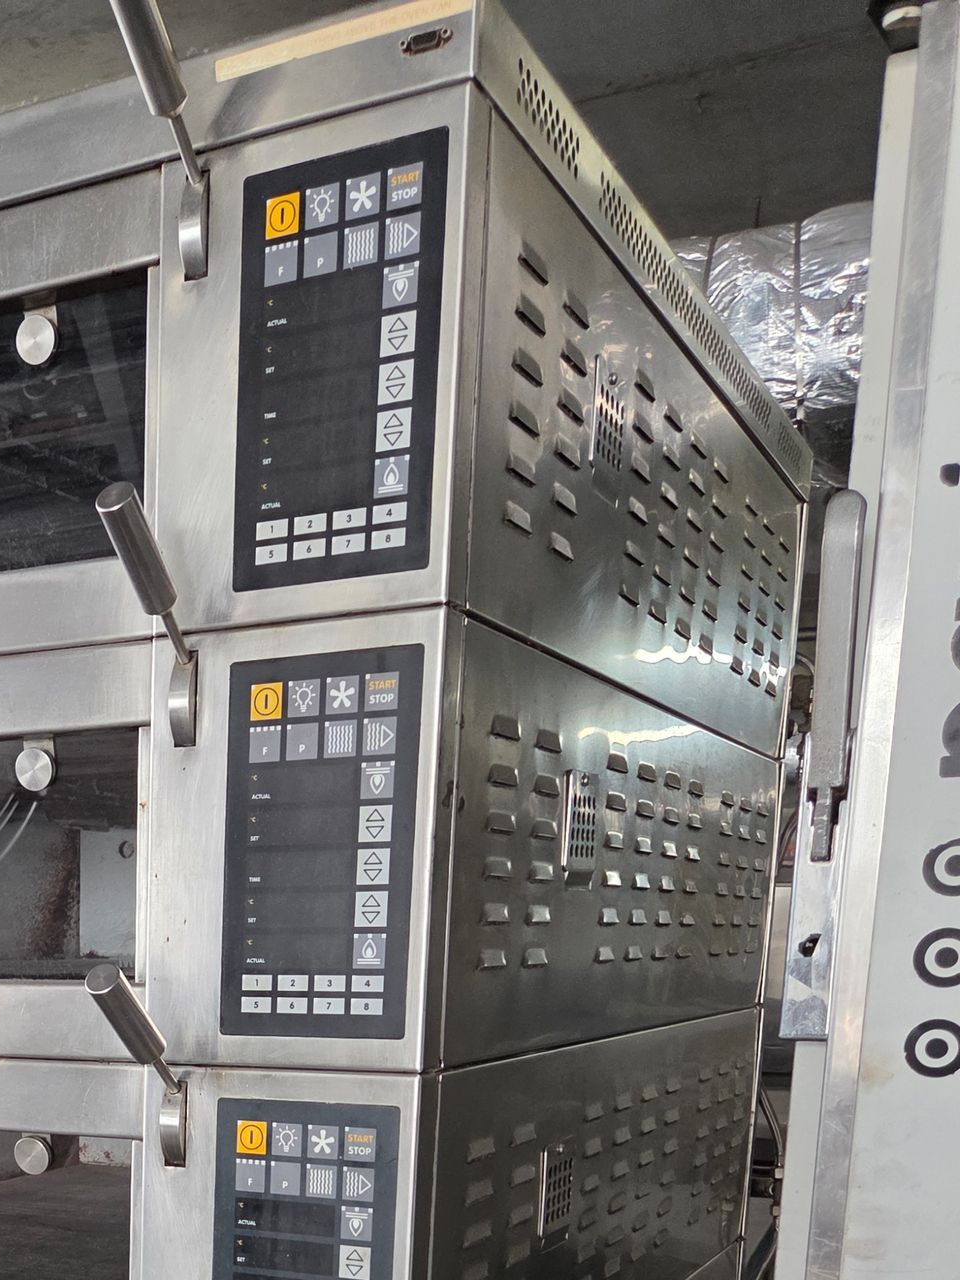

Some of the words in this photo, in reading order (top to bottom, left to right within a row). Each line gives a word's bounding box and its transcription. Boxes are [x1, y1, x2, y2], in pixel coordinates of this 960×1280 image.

[391, 170, 420, 186] START
[392, 187, 417, 202] STOP
[279, 266, 283, 277] F
[317, 258, 324, 268] P
[267, 318, 287, 327] ACTUAL
[265, 366, 275, 374] SET
[261, 502, 281, 510] ACTUAL
[368, 680, 396, 690] START
[369, 694, 394, 704] STOP
[263, 747, 268, 756] F
[299, 744, 305, 753] P
[347, 1134, 373, 1143] START
[348, 1147, 371, 1156] STOP
[248, 1178, 253, 1186] F
